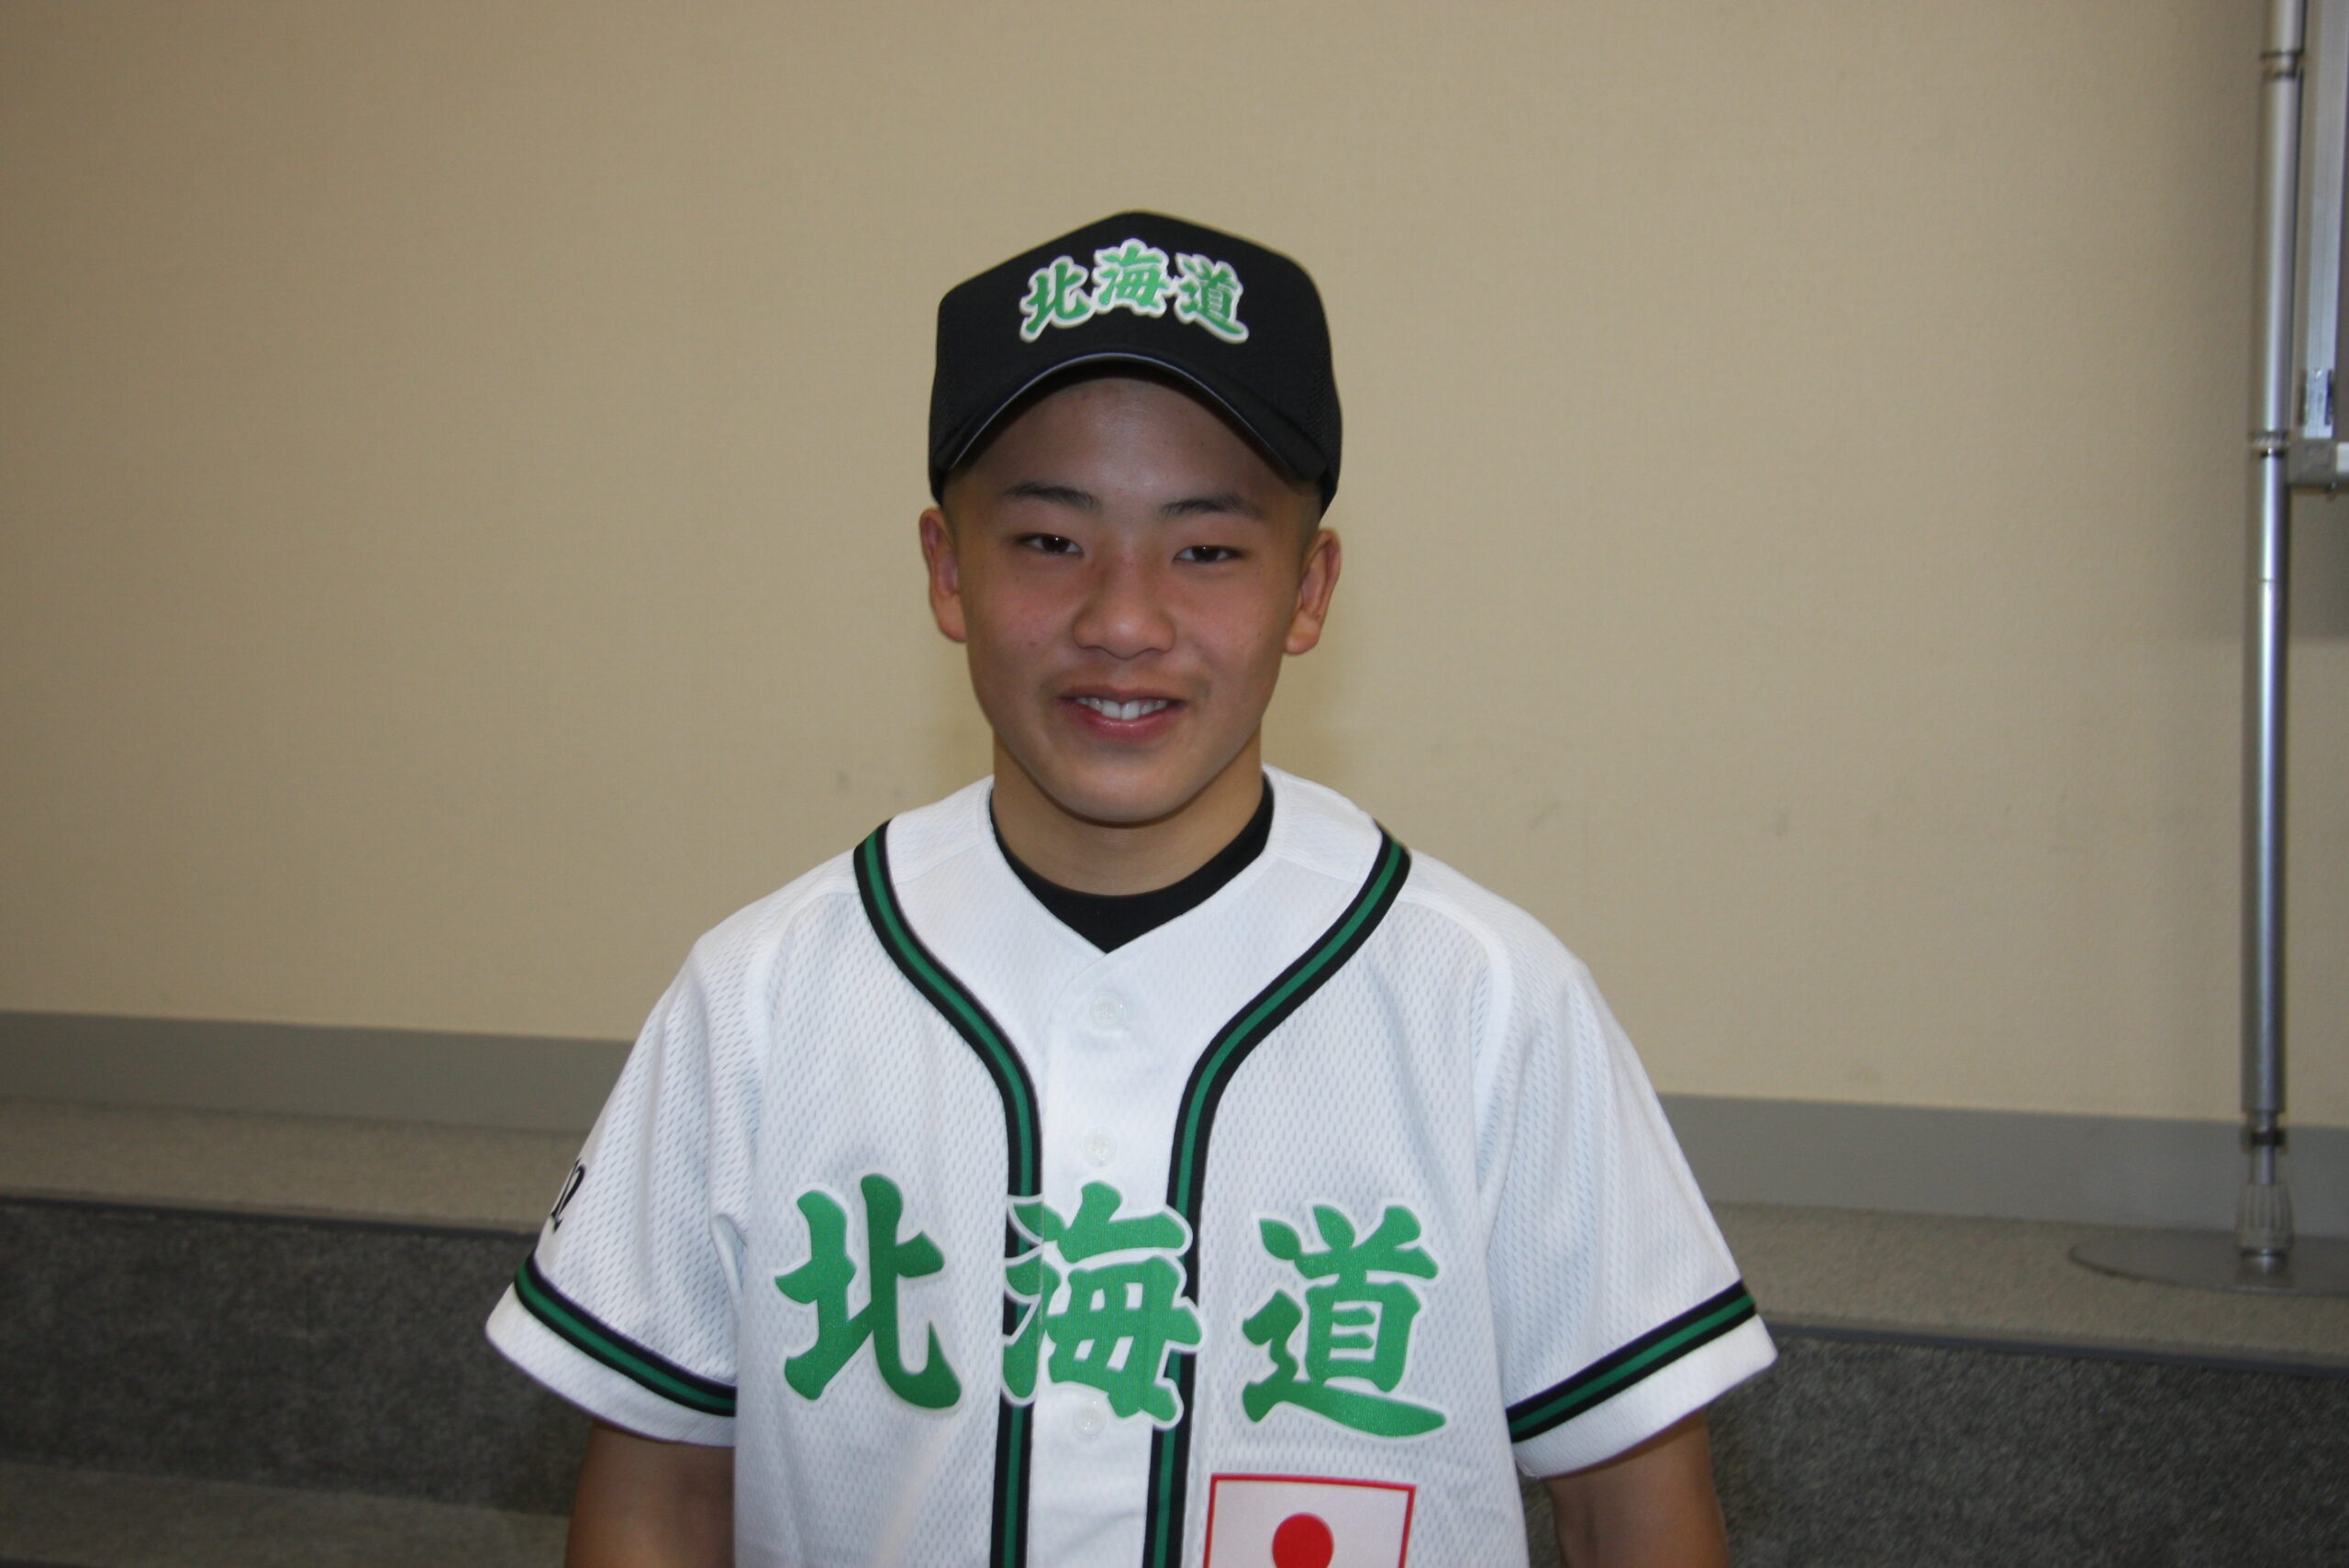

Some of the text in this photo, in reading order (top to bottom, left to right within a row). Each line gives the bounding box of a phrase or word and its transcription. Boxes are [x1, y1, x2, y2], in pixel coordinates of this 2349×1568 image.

[1019, 239, 1249, 344] 北海道
[774, 1172, 1447, 1438] 北海道
